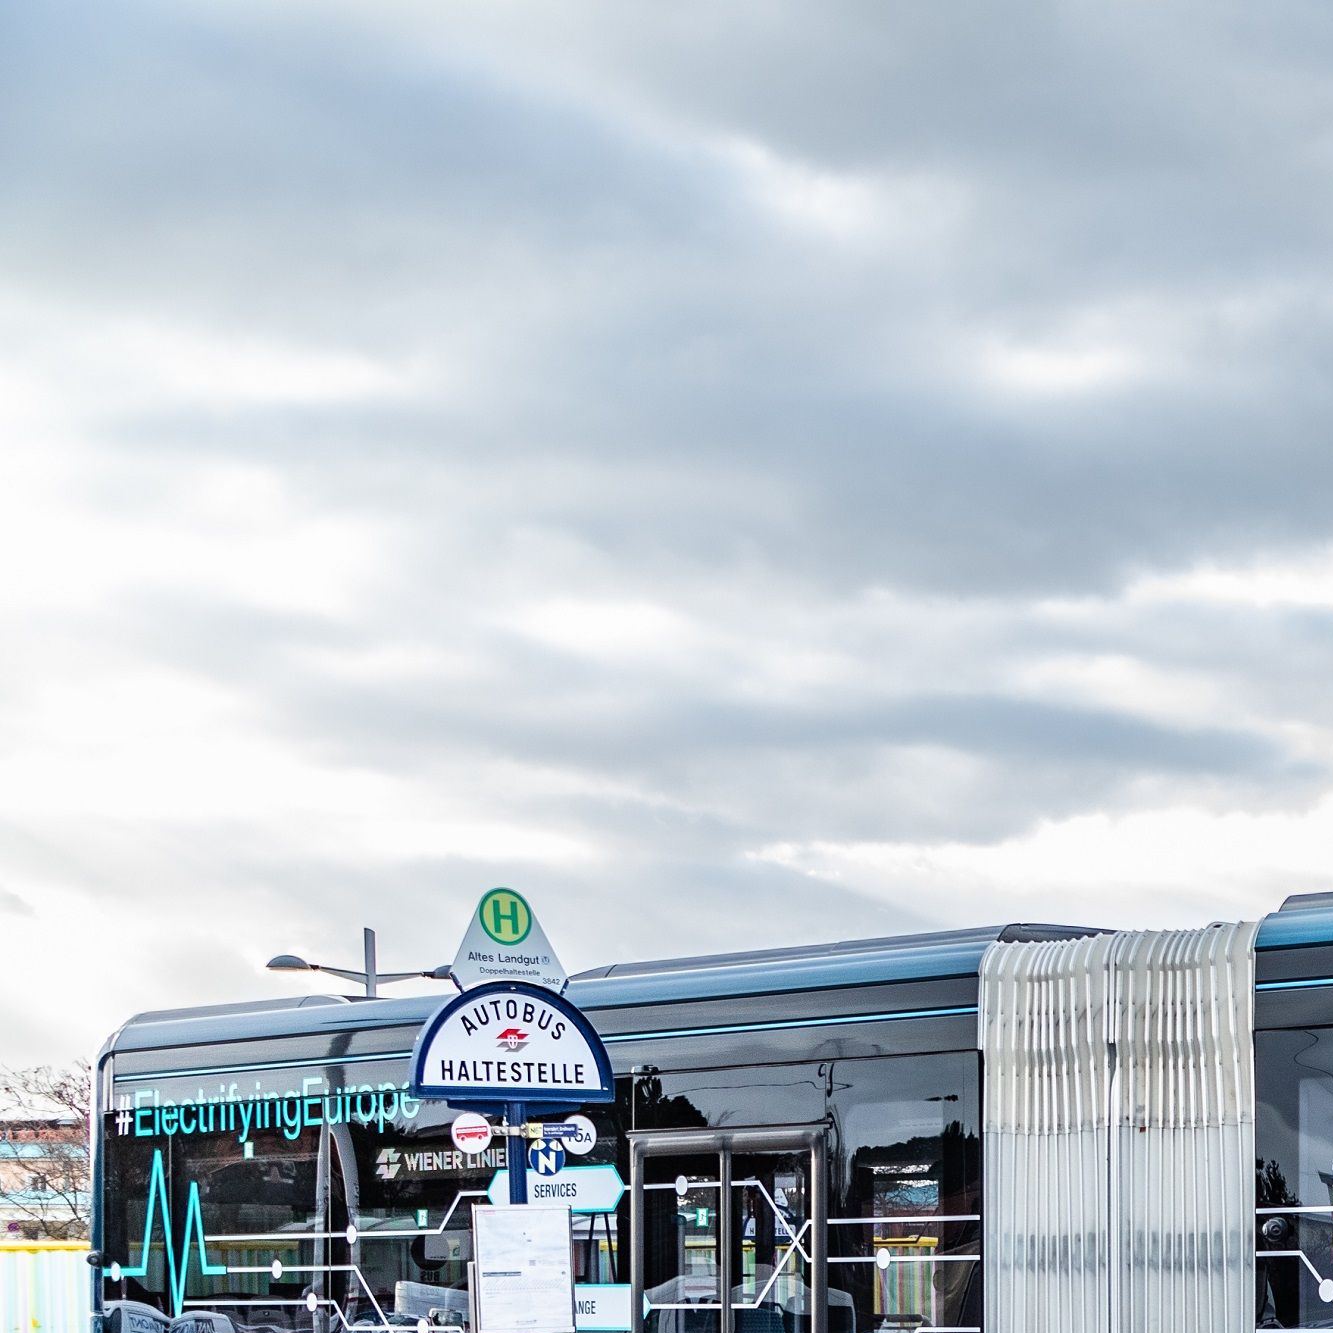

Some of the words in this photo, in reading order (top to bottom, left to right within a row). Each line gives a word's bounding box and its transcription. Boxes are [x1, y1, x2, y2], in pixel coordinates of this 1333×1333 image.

[492, 899, 520, 935] H
[468, 951, 494, 962] Altes
[498, 953, 540, 966] Landgut
[479, 967, 541, 977] Doppelhaltestelle
[460, 999, 566, 1041] AUTOBUS
[441, 1059, 585, 1084] HALTESTELLE
[115, 1076, 420, 1143] #ElectrifyingEurope
[404, 1151, 463, 1171] WIENER
[538, 1151, 556, 1173] N
[534, 1183, 577, 1198] SERVICES
